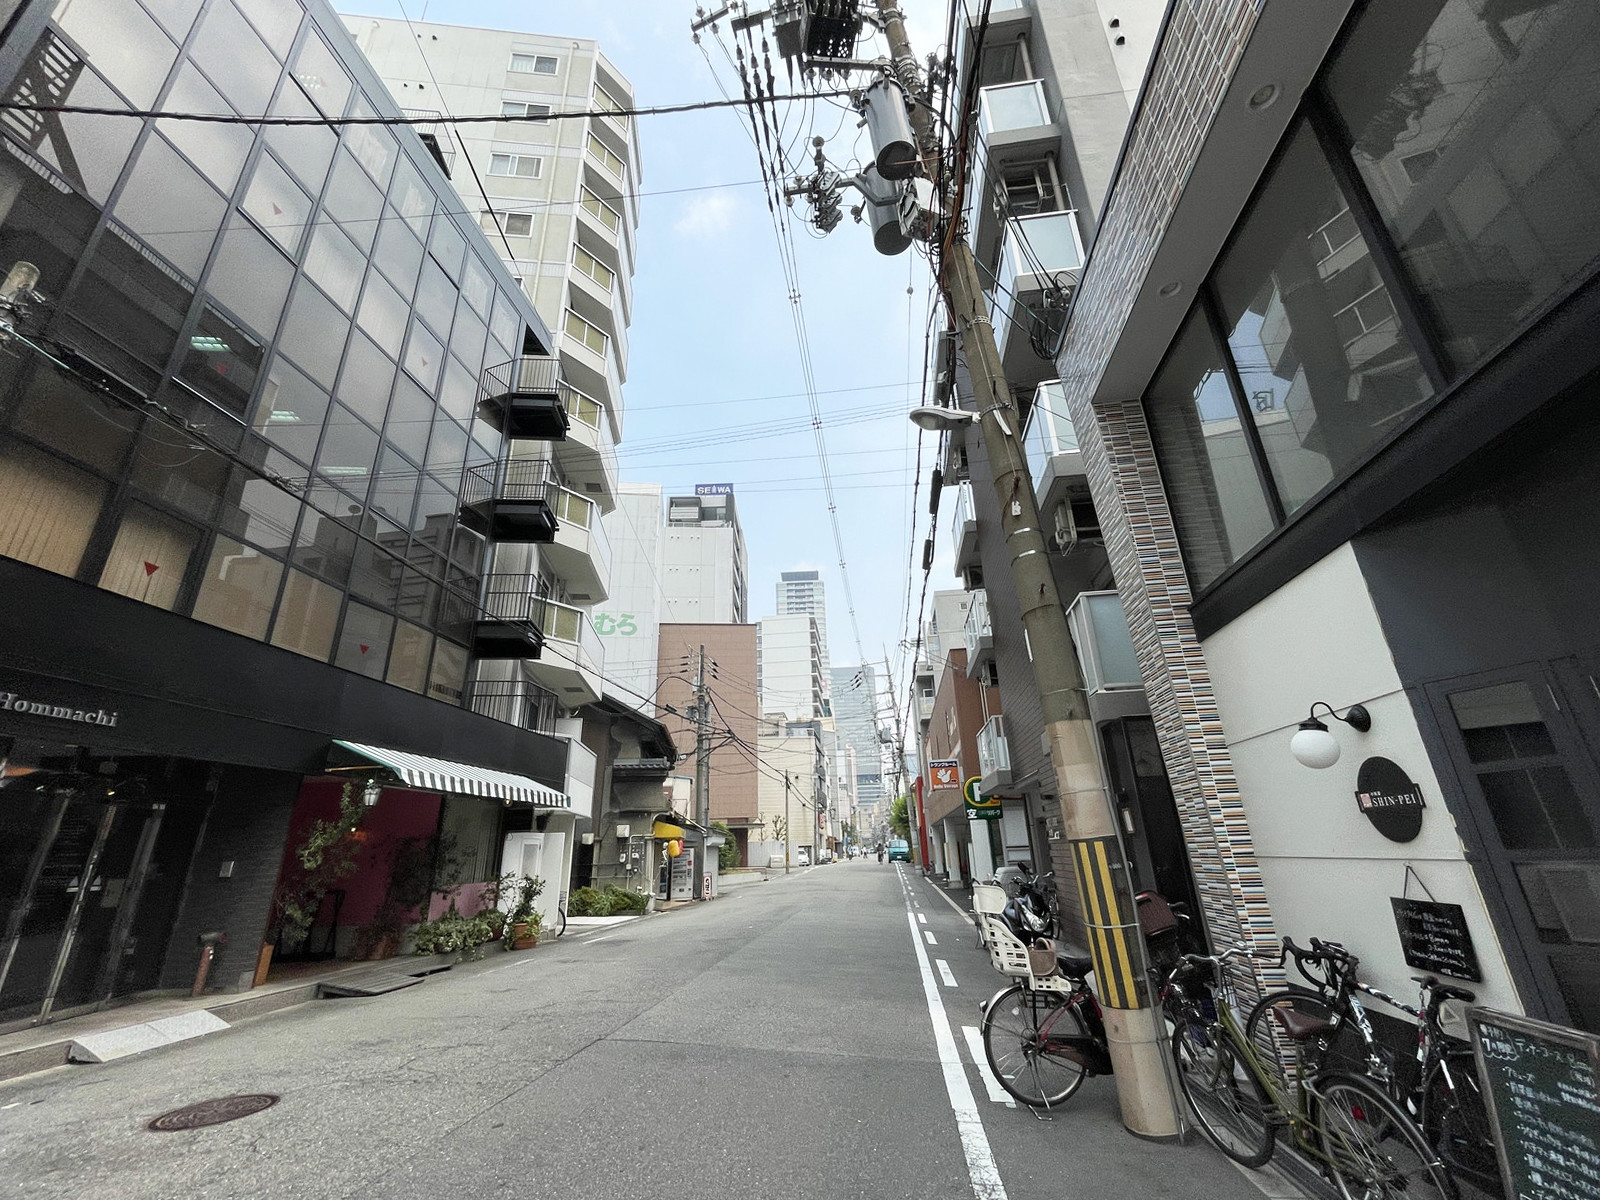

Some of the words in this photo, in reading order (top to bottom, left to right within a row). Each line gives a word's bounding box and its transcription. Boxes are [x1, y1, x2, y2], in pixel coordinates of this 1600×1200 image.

[697, 485, 731, 495] SEIWA
[0, 691, 119, 727] Hommachi
[1372, 793, 1416, 807] SHIN-PEI
[966, 808, 977, 819] 空
